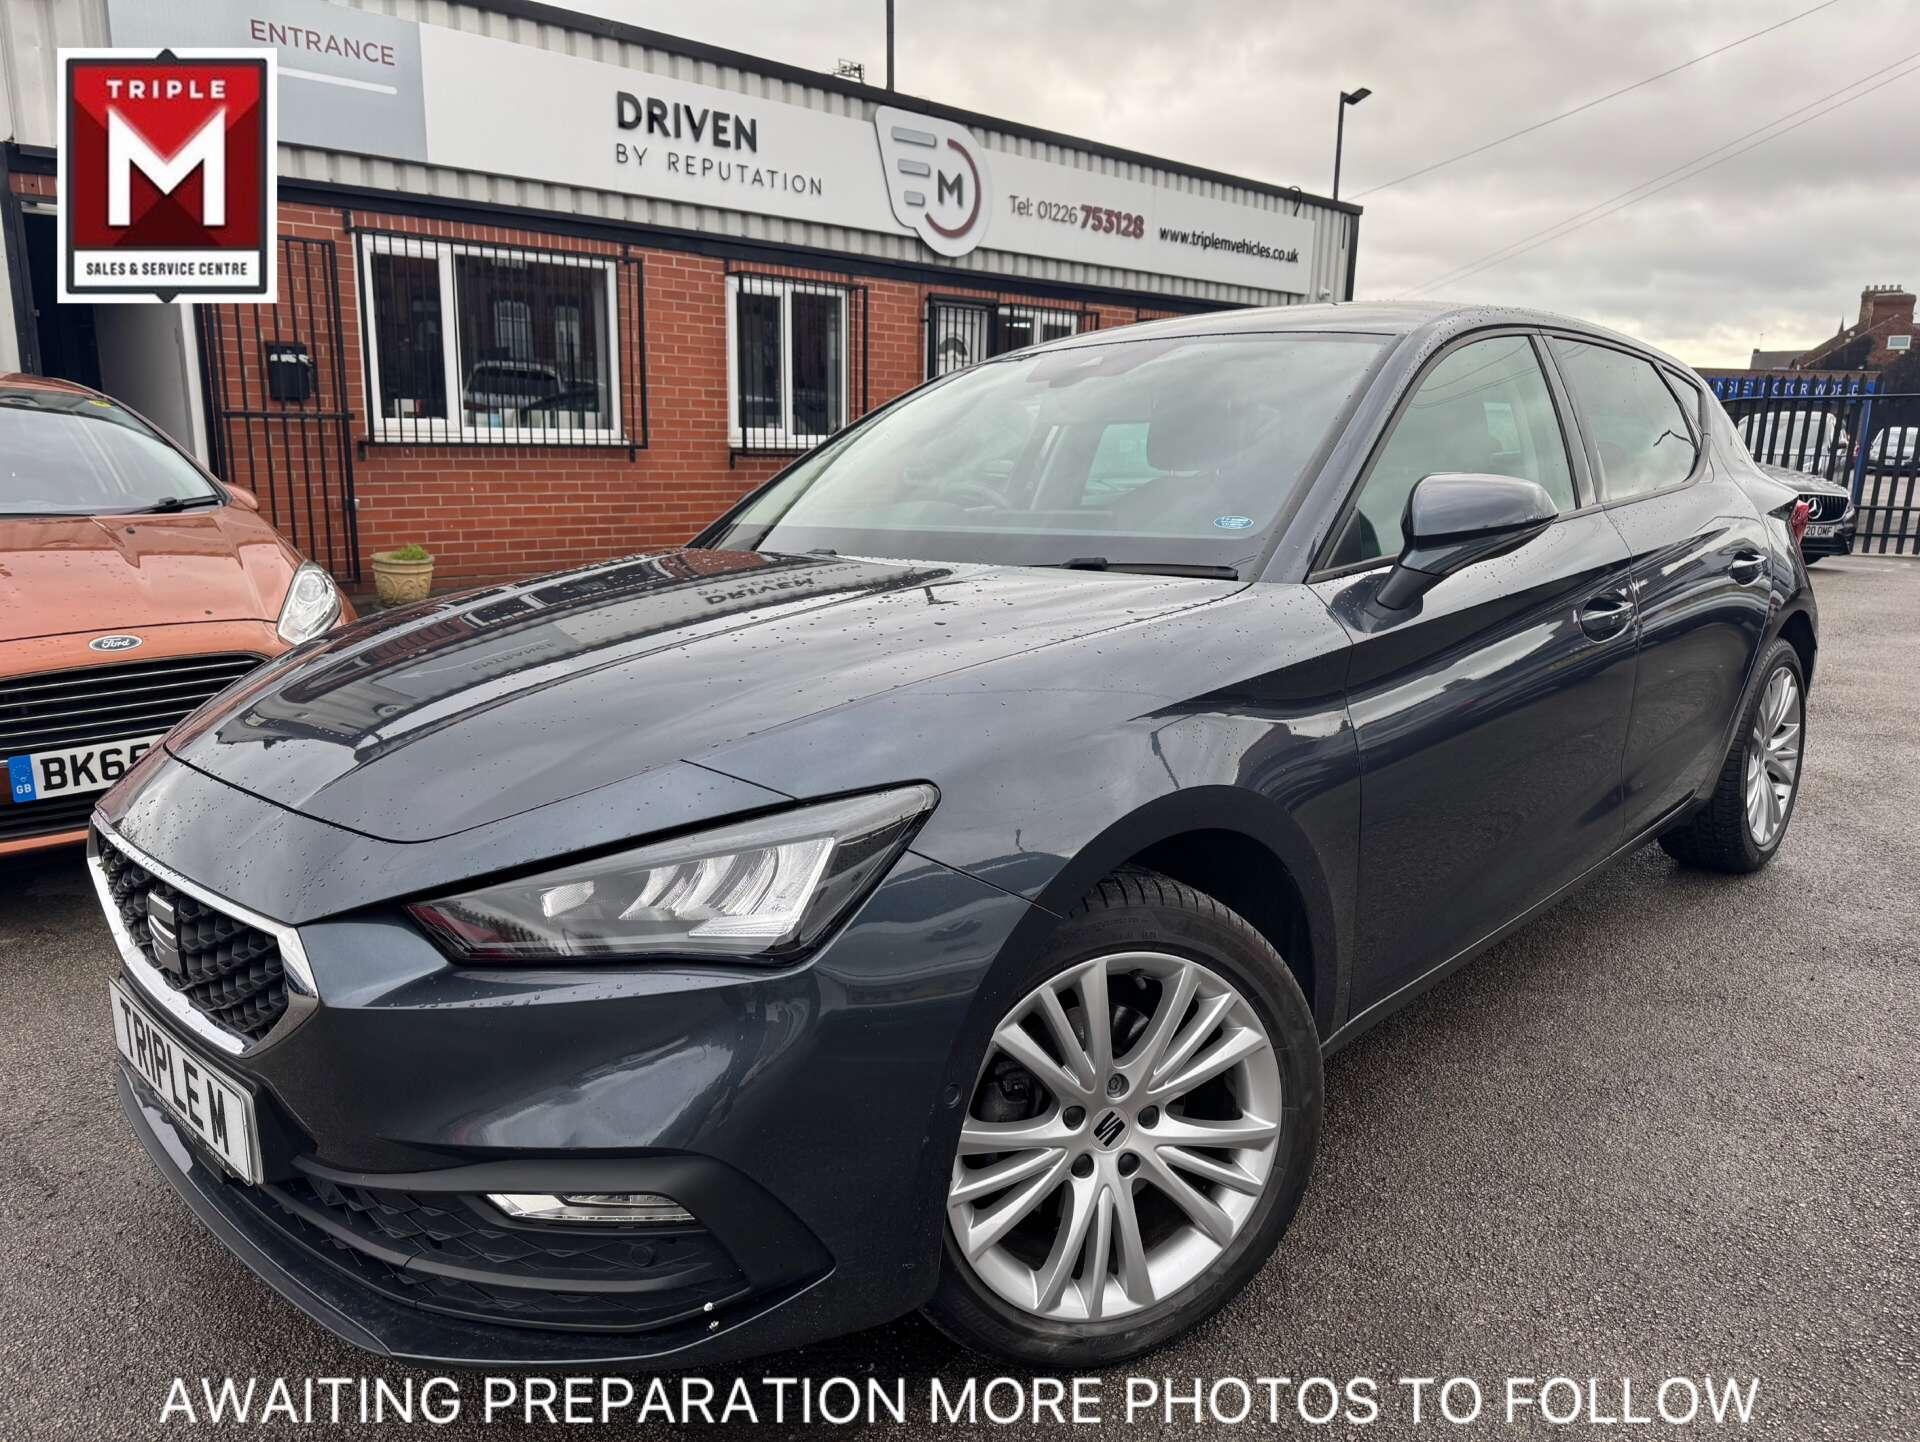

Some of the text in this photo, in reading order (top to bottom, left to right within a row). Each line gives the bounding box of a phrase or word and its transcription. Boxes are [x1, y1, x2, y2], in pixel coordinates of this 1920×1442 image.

[250, 19, 396, 66] ENTRANCE
[616, 91, 758, 152] DRIVEN
[616, 143, 823, 196] BY REPUTATION
[937, 168, 964, 208] M
[1009, 195, 1299, 264] Tel: 01226 753128 www.triplemvehicles.co.uk
[102, 637, 130, 649] Ford
[15, 784, 32, 794] GB
